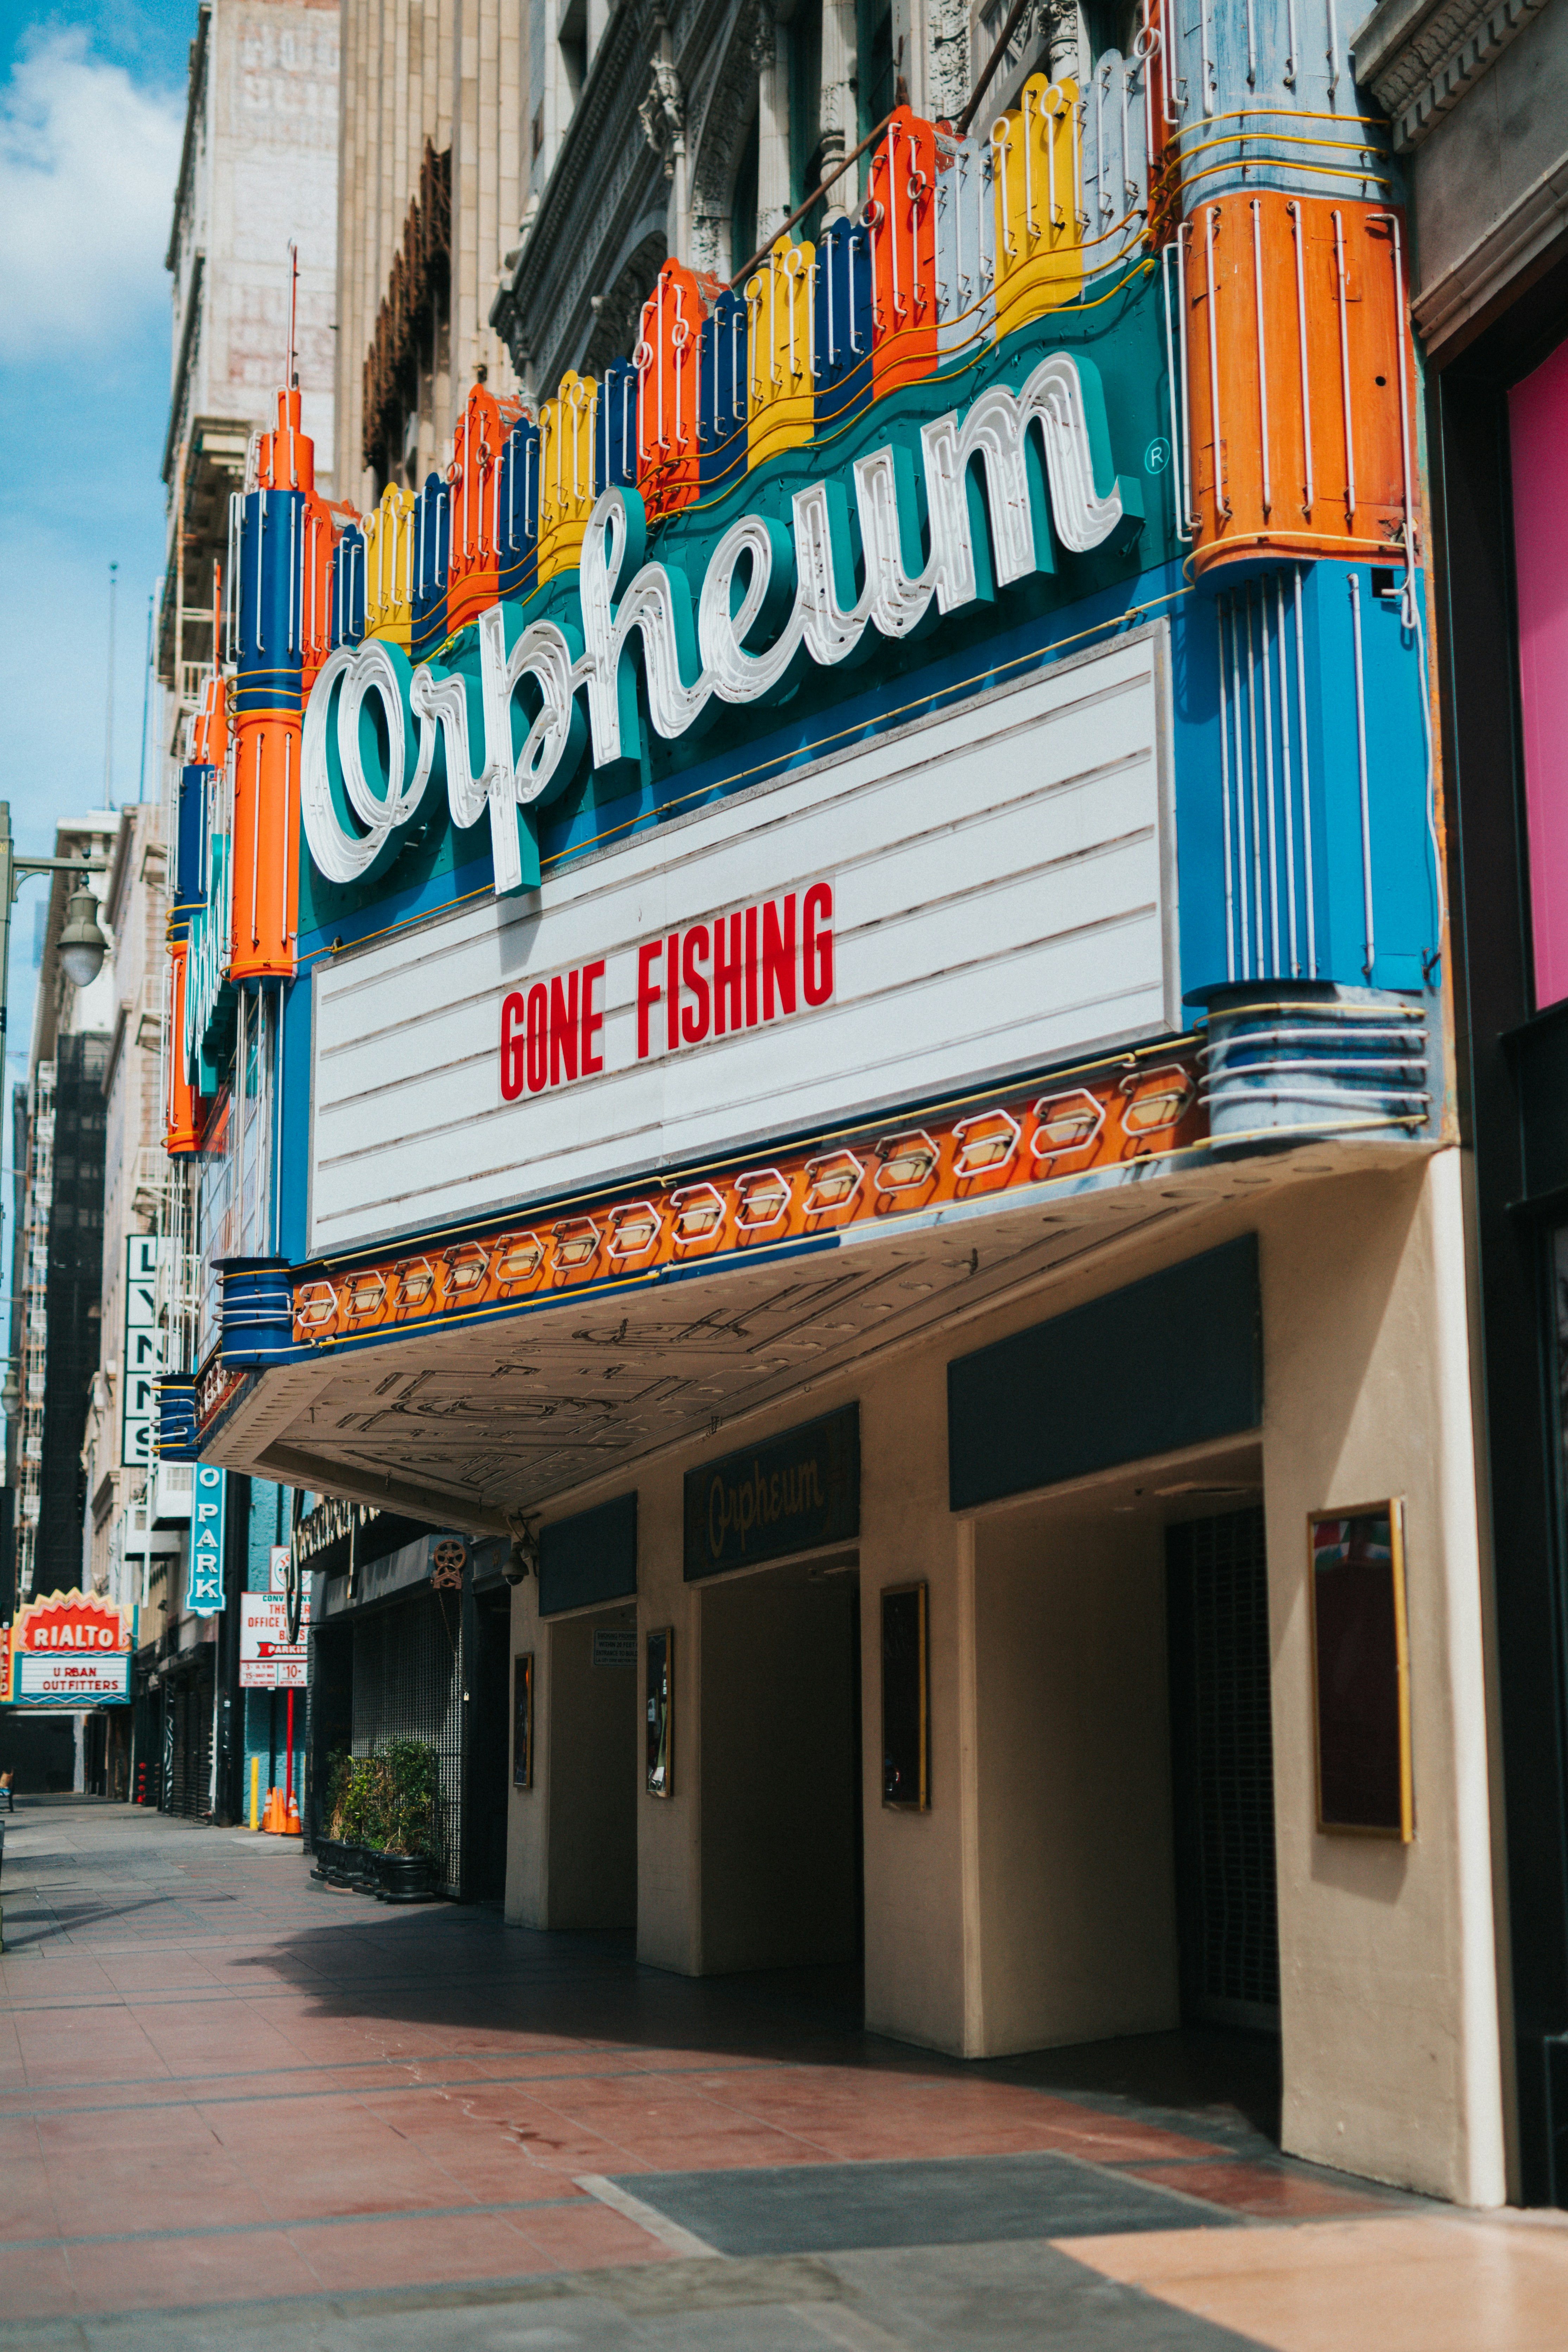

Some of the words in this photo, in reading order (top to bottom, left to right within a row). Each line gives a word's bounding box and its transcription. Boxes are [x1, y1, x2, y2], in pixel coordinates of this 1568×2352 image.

[300, 351, 1142, 897] Orpheum
[501, 959, 605, 1100] GONE
[638, 883, 833, 1058] FISHING
[196, 1503, 219, 1598] PARK
[709, 1459, 824, 1558] Orpheum
[34, 1624, 114, 1647] RIALTO
[248, 1617, 279, 1627] OFFICE
[43, 1681, 119, 1690] OUTFITTERS
